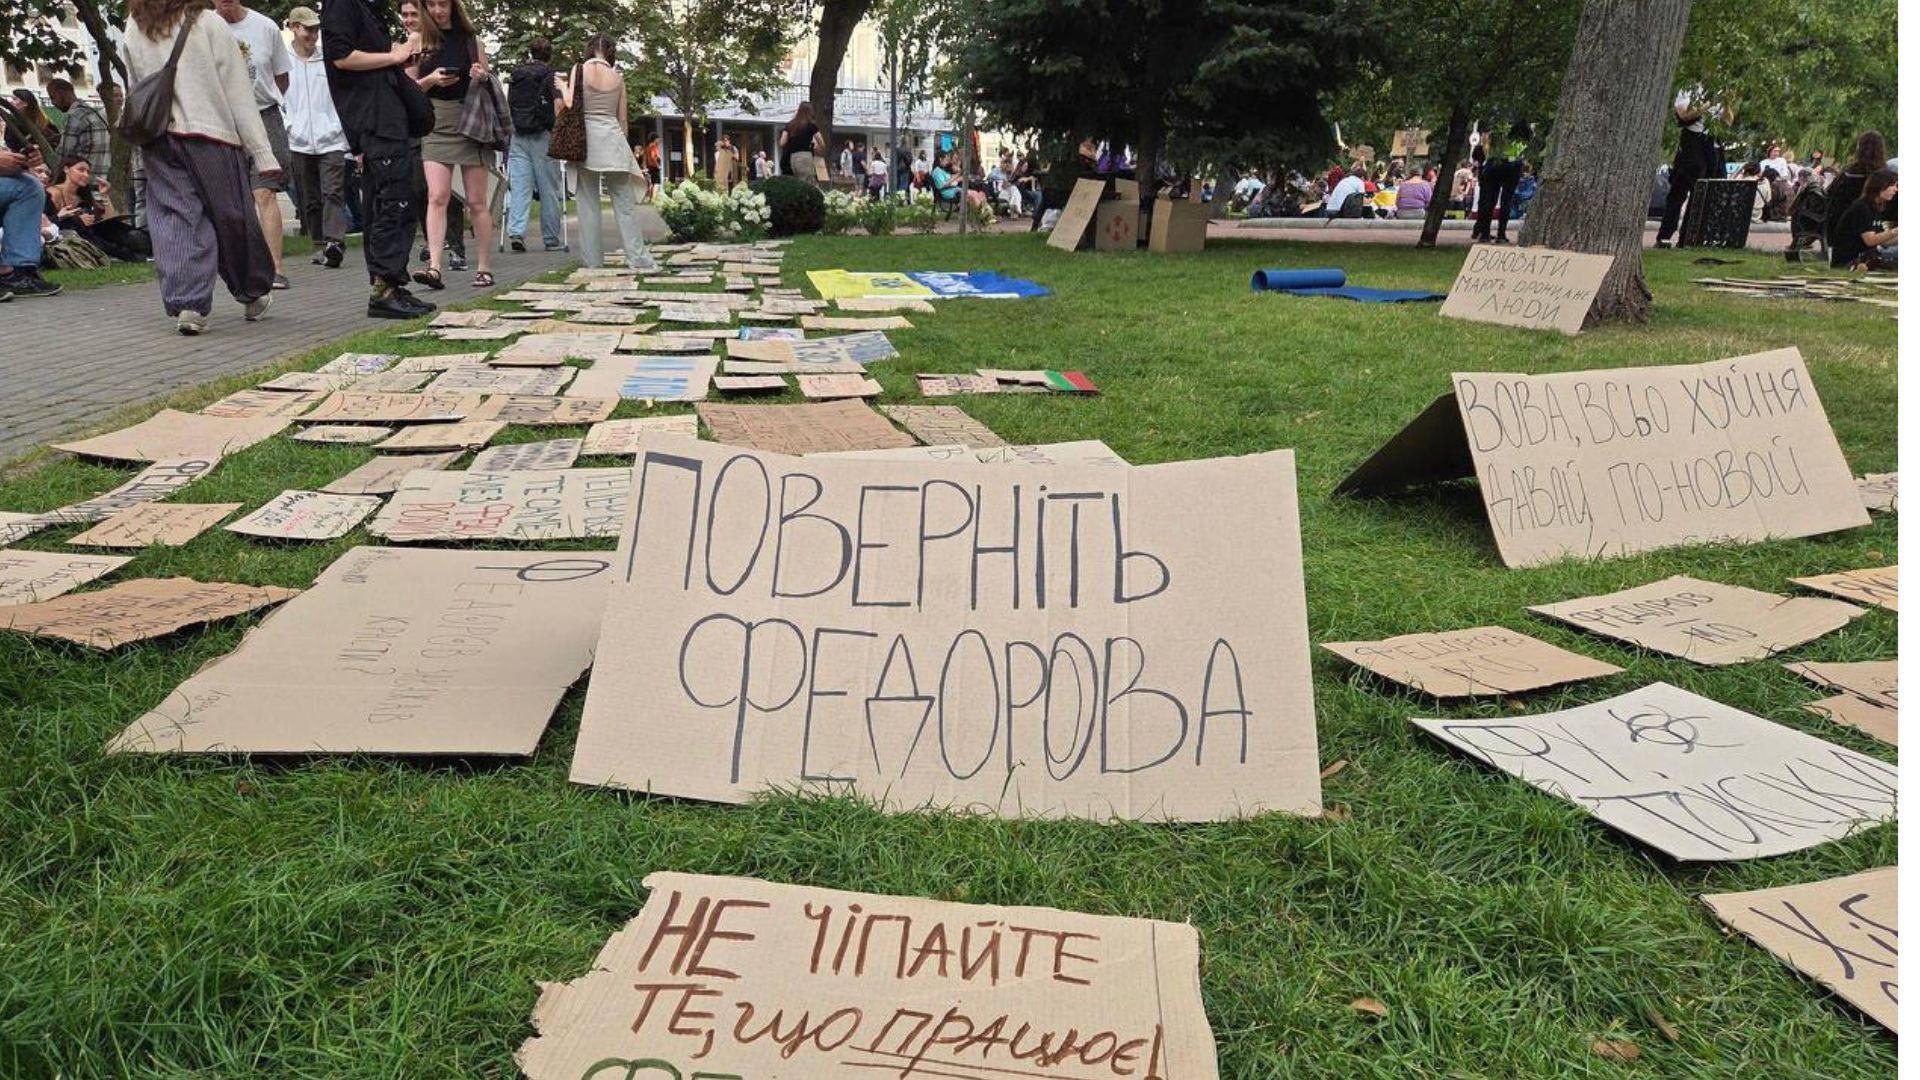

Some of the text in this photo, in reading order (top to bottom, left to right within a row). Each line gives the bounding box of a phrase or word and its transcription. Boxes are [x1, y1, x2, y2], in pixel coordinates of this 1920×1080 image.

[1459, 364, 1809, 453] ВОВА, ВСЬО ХУЙНЯ
[1608, 434, 1810, 526] ПО-НОВОЙ
[678, 613, 1254, 785] ФЕДОРОВА
[637, 890, 771, 979] НЕ
[630, 983, 724, 1060] ТЕ,
[733, 1000, 863, 1053] ЩО
